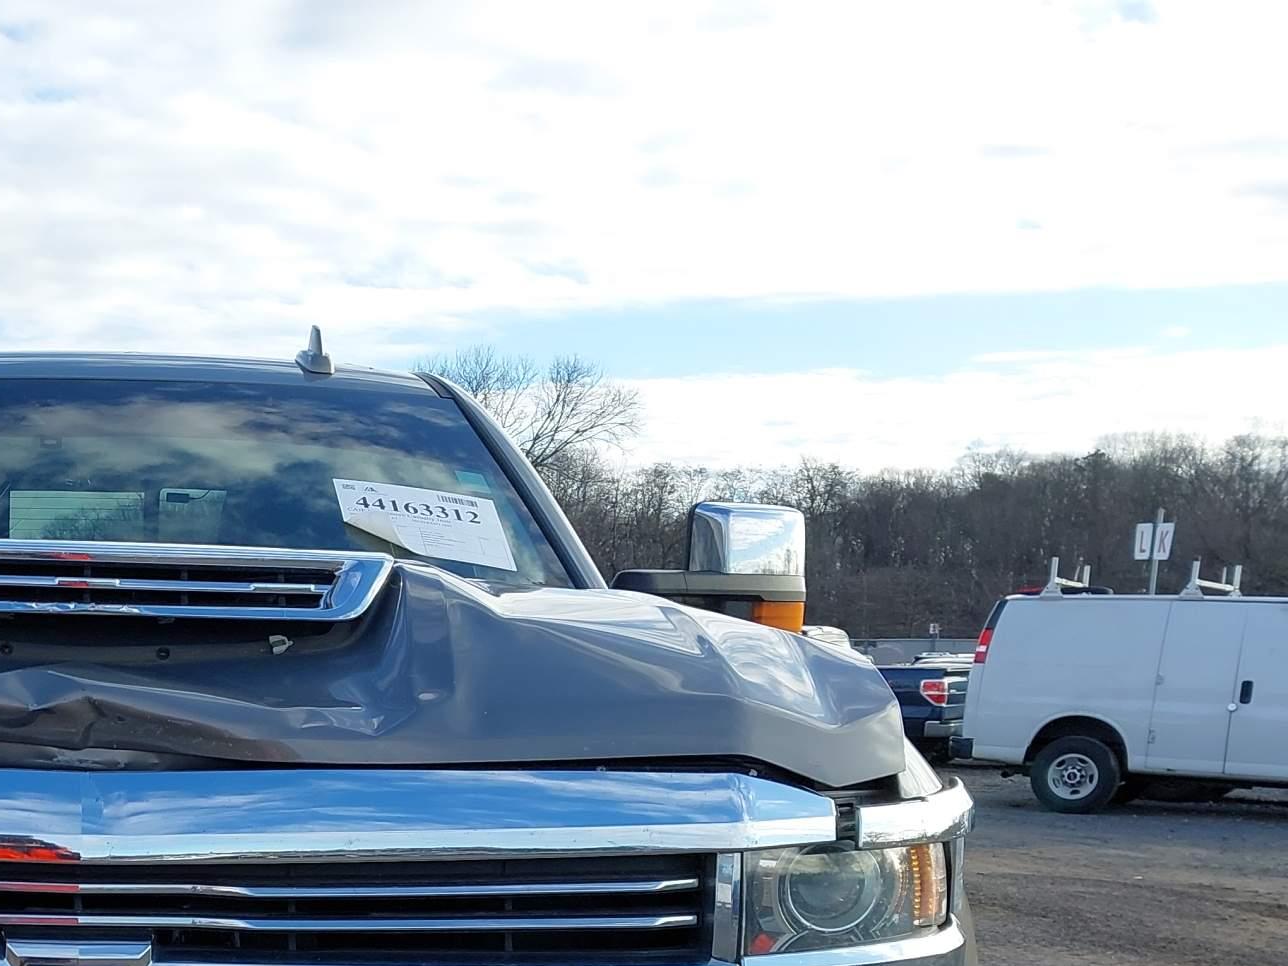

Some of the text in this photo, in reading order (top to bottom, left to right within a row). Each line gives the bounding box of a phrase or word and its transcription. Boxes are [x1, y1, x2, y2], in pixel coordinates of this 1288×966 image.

[355, 496, 481, 525] 44163312
[1139, 530, 1147, 554] L
[1157, 530, 1169, 554] K
